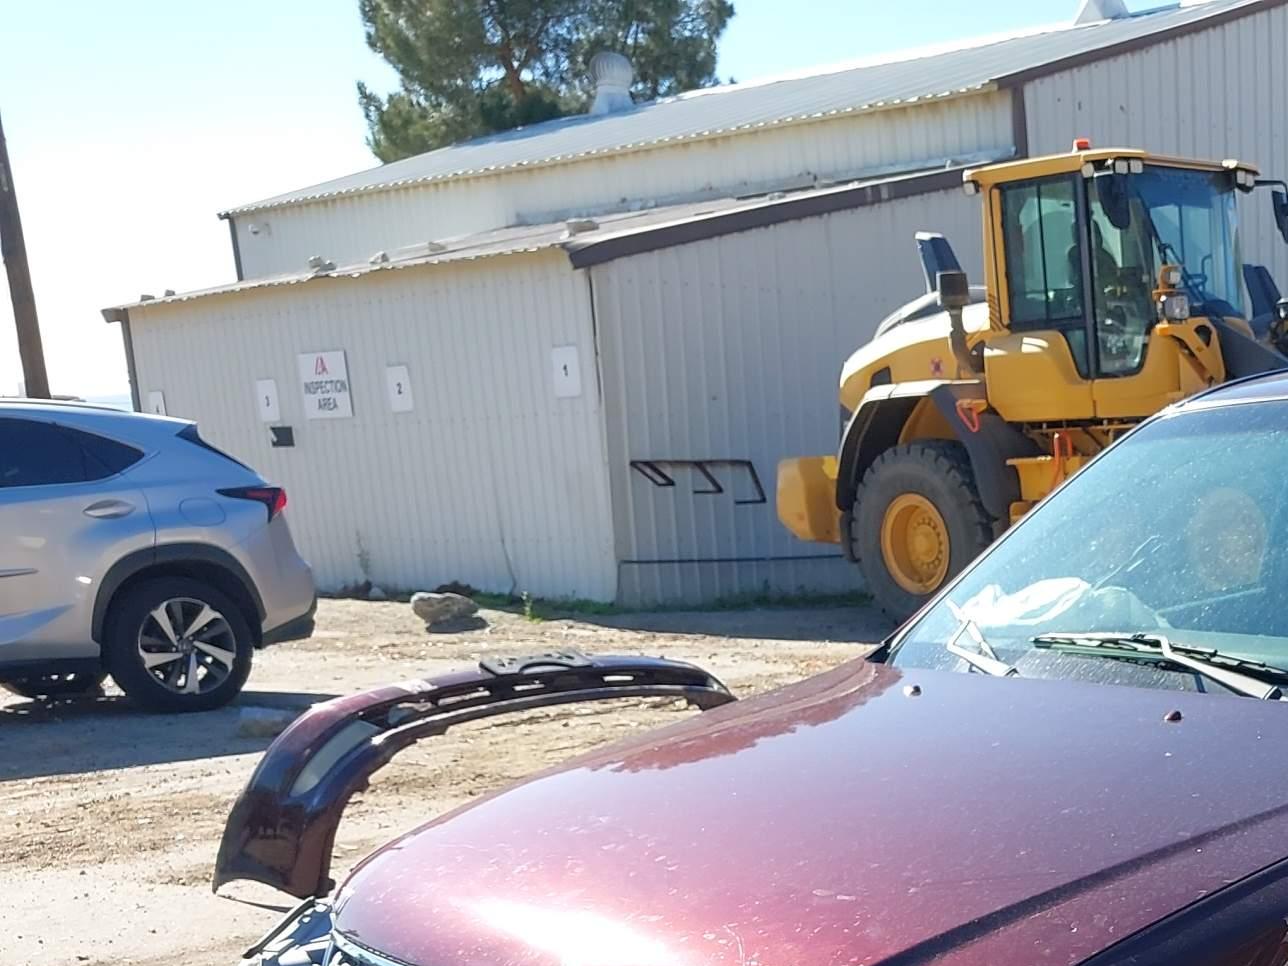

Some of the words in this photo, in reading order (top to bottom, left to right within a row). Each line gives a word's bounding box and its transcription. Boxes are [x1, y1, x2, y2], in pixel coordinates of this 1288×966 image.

[304, 379, 347, 395] INSPECTION
[396, 382, 403, 395] 2
[317, 397, 338, 411] AREA
